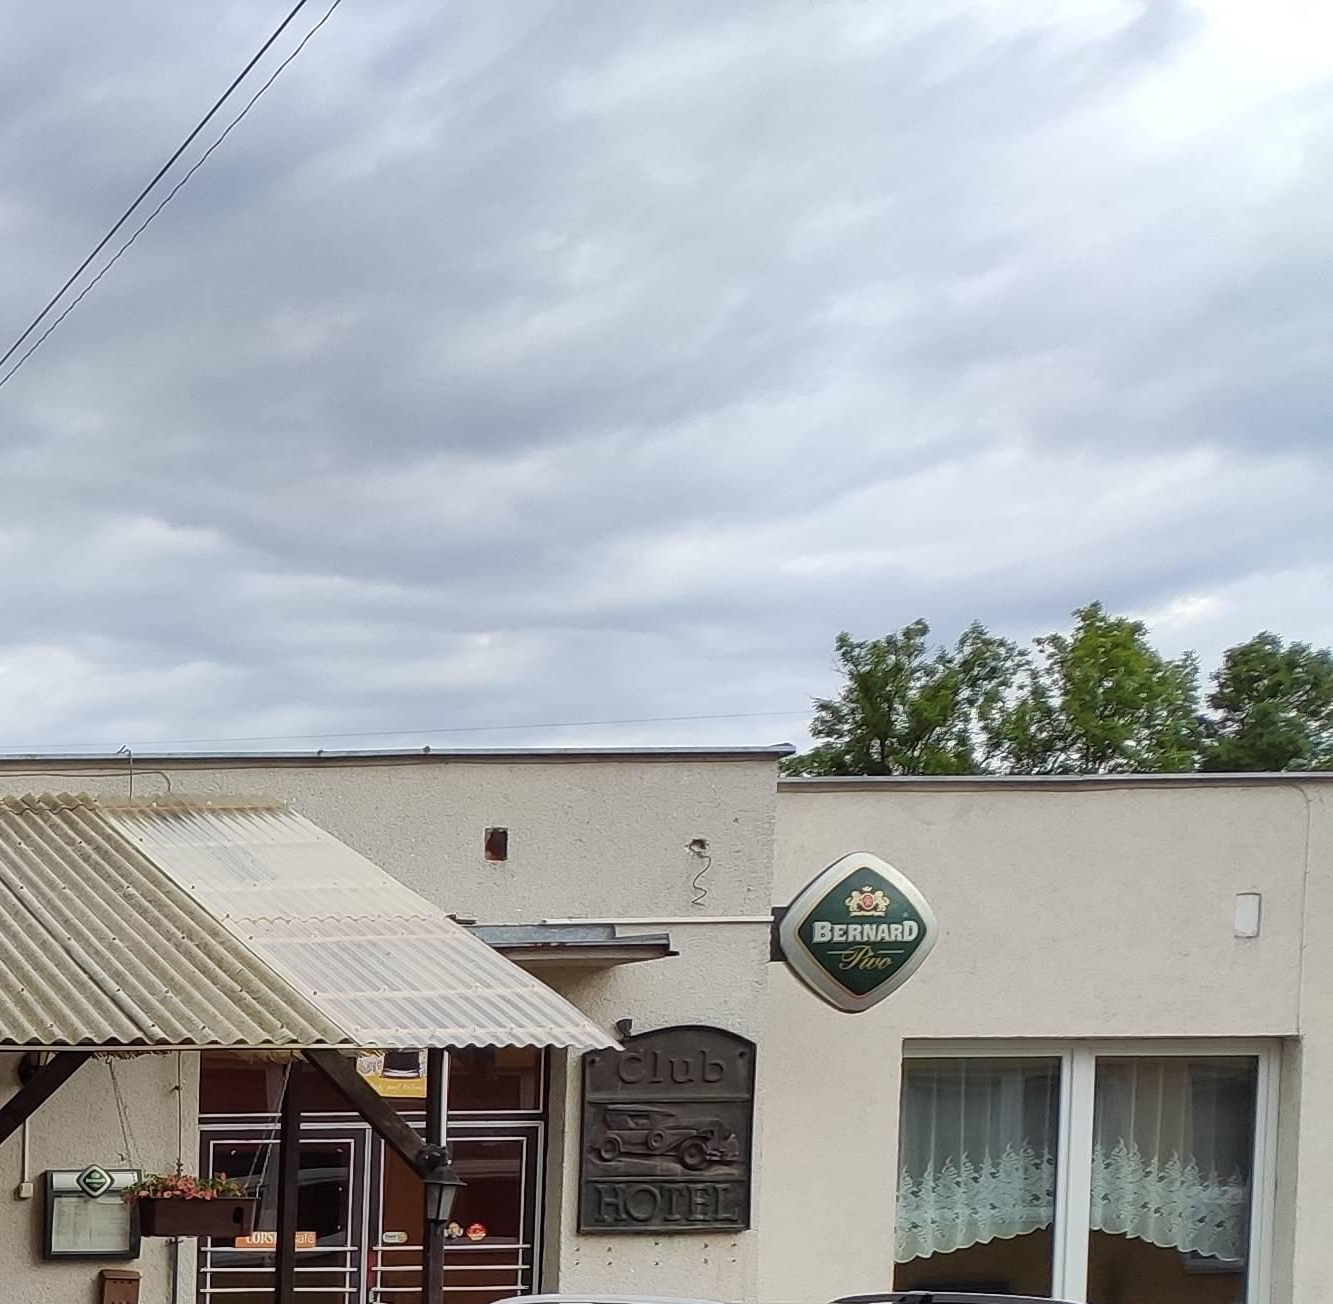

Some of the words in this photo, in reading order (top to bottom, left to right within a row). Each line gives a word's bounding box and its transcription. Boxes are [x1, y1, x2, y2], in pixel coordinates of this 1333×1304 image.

[811, 920, 919, 943] BERNARD
[839, 944, 893, 970] Pivo
[617, 1049, 726, 1084] Club
[595, 1184, 740, 1222] HOTEL
